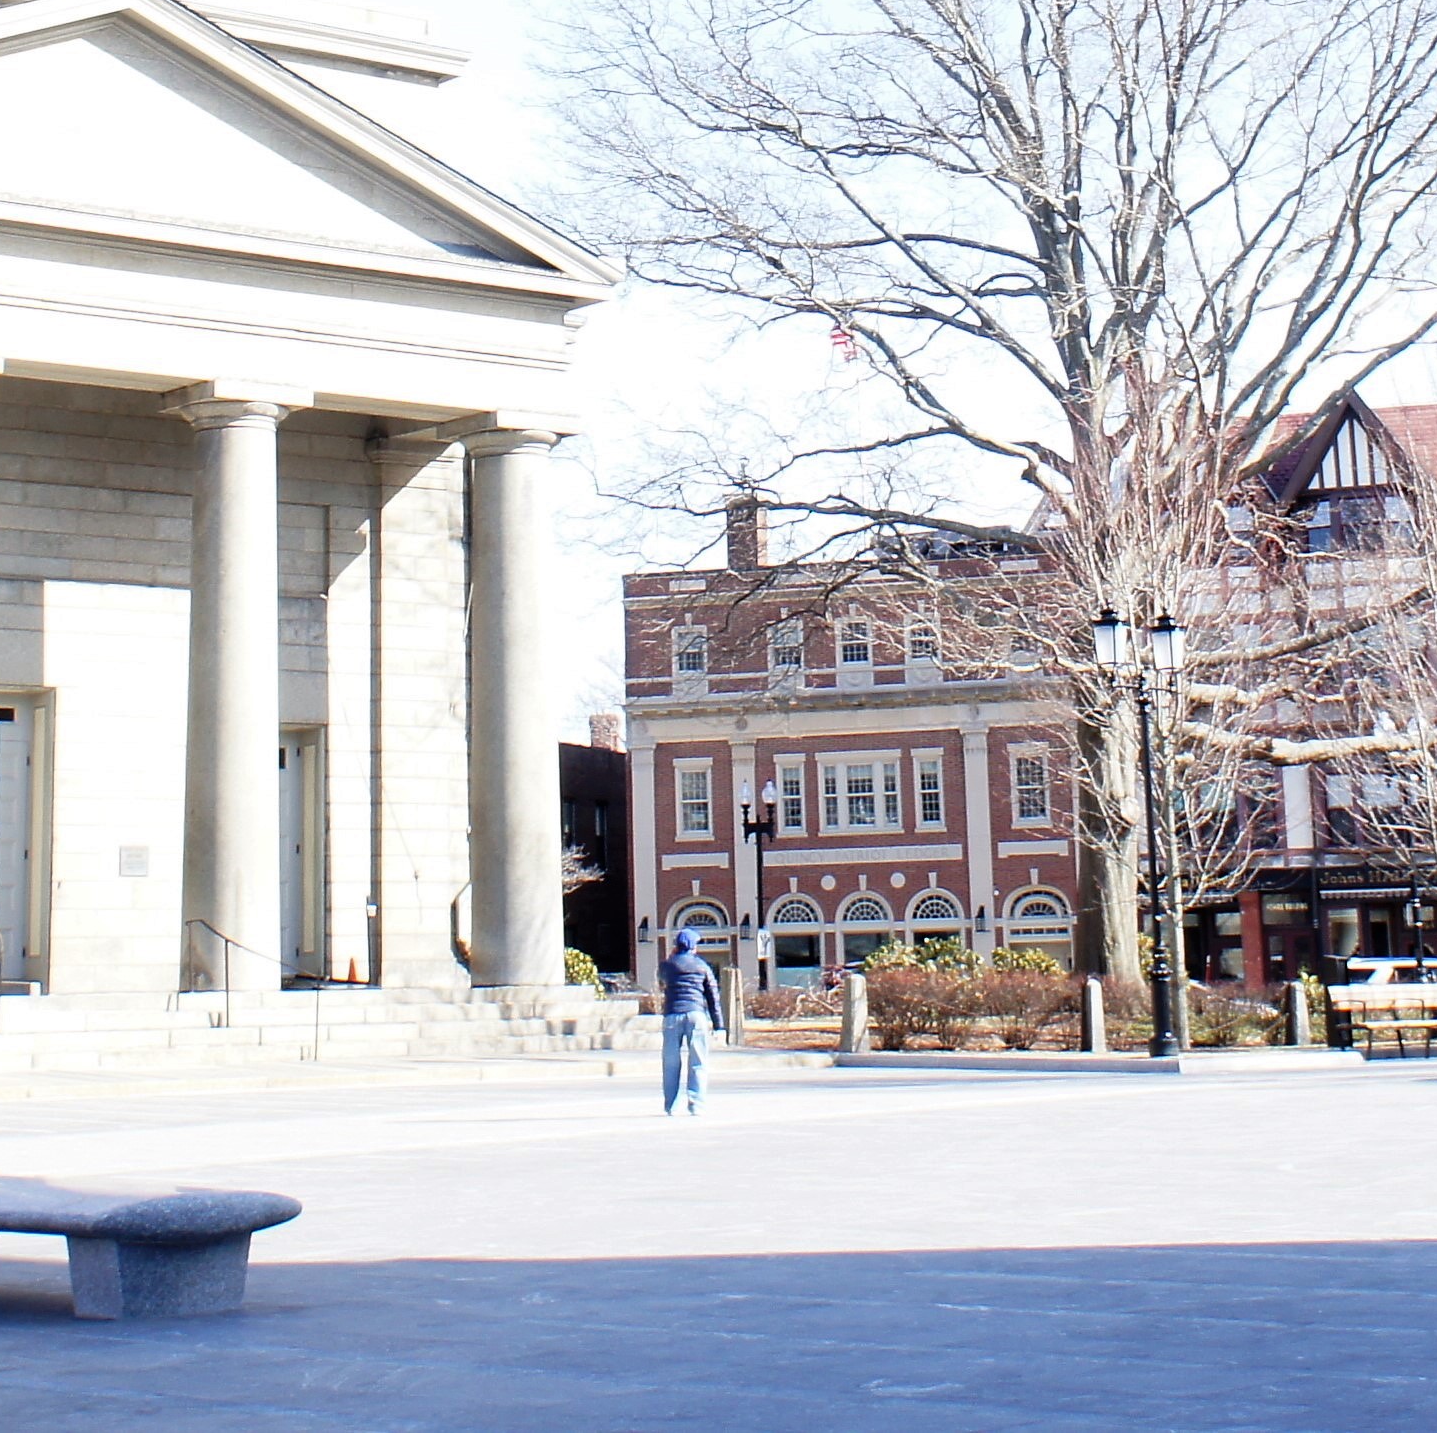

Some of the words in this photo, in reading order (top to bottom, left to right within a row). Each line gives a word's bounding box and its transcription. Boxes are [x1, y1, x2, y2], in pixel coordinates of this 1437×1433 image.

[774, 852, 824, 864] QUINCY
[834, 849, 887, 862] PATRIOT
[896, 847, 948, 860] LEDGER
